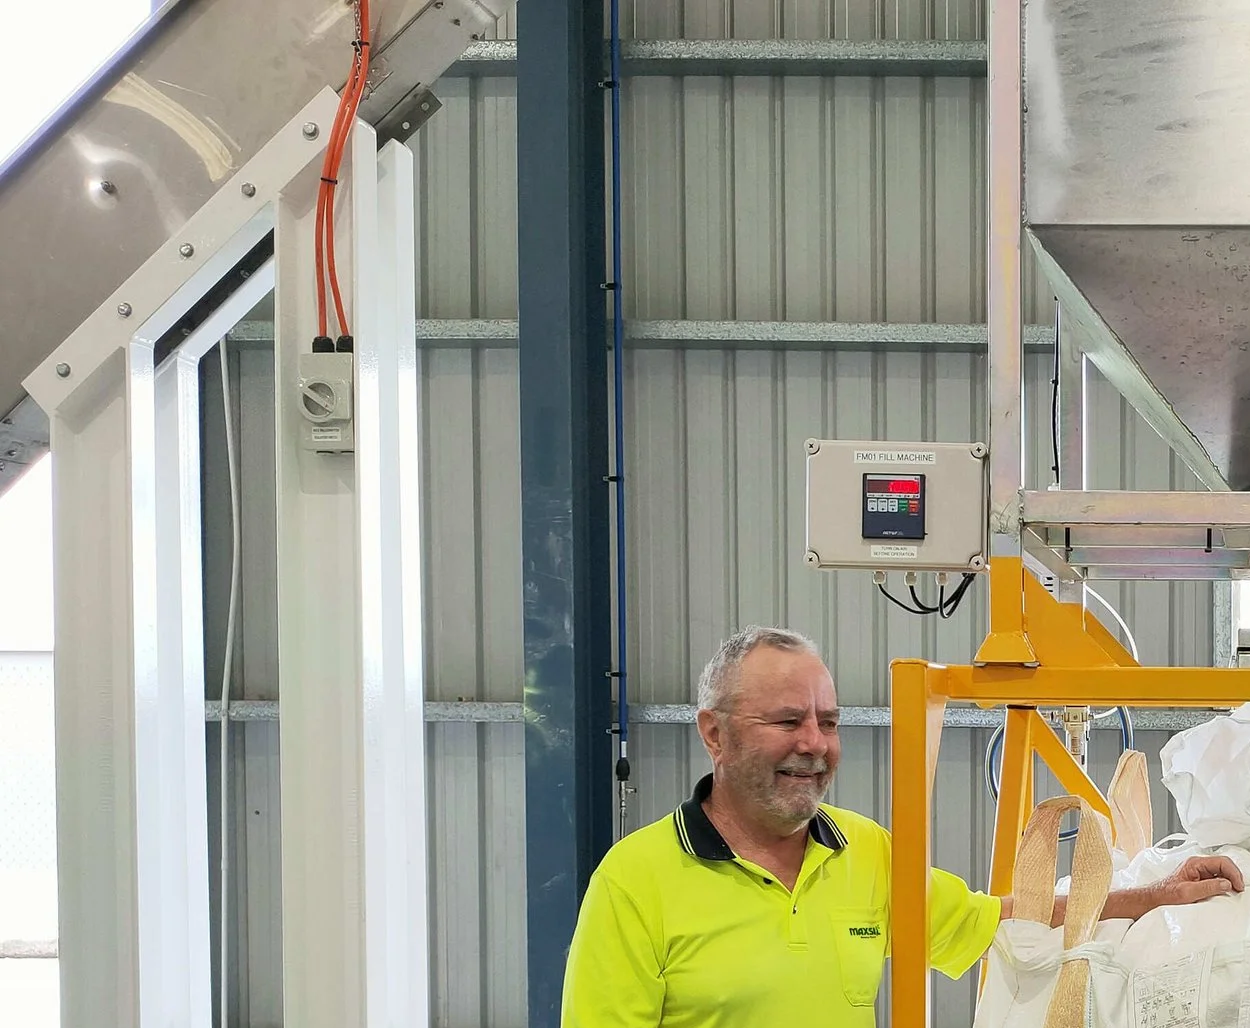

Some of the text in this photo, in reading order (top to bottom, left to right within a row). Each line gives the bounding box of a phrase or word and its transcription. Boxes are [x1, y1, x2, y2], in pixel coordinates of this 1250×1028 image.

[856, 452, 934, 462] FM01 FILL MACHINE
[849, 926, 881, 936] MAXSIL
